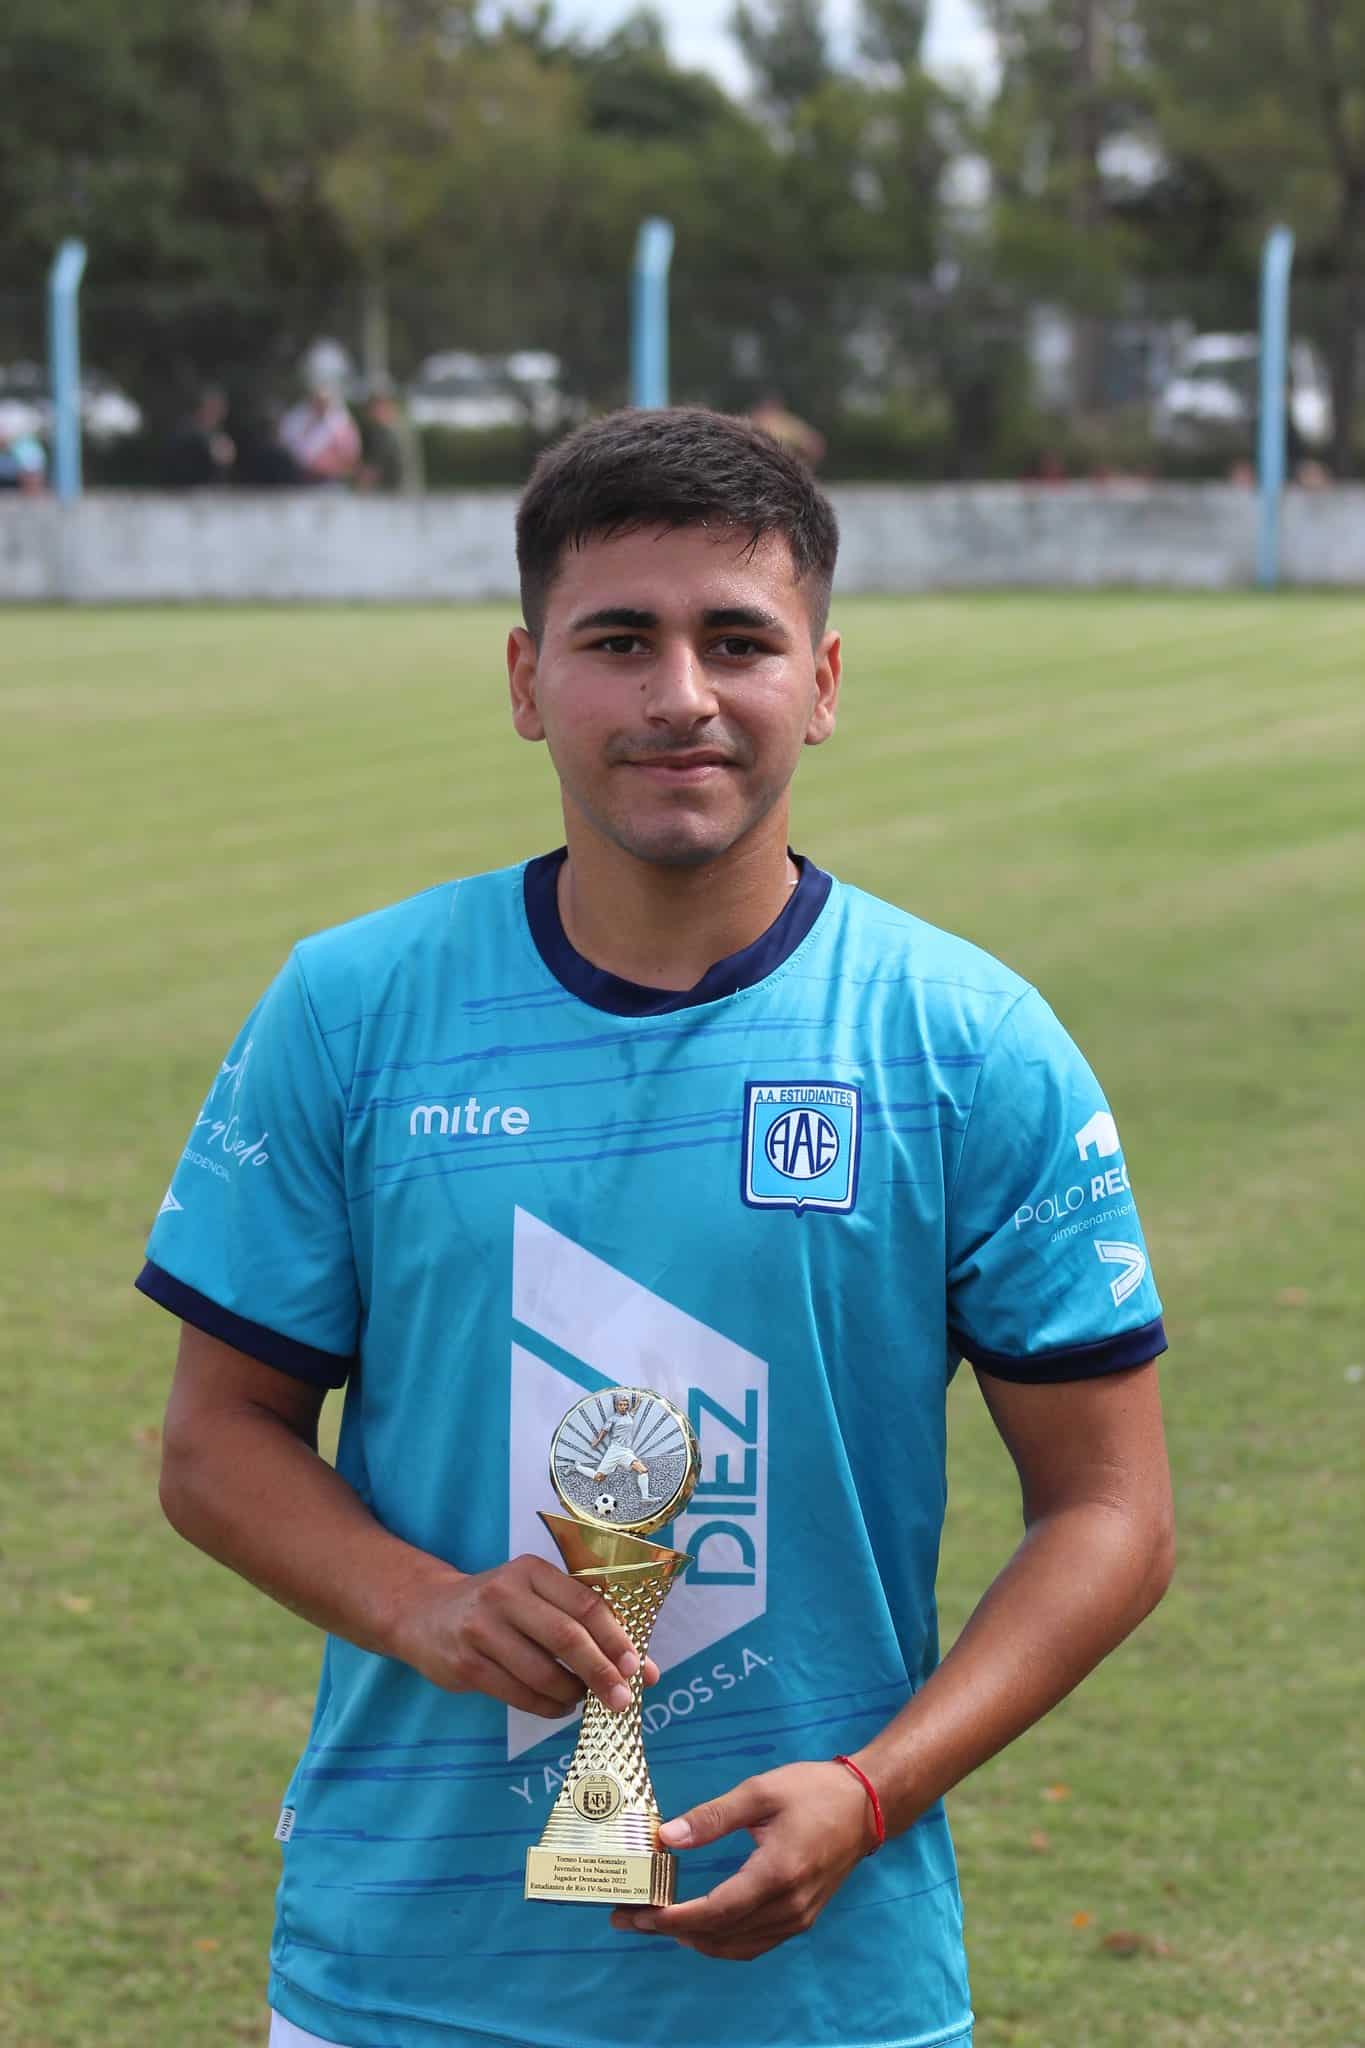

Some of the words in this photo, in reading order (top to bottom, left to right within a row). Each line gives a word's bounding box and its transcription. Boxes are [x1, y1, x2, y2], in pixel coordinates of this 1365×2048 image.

[409, 1097, 530, 1136] mitre
[756, 1089, 777, 1103] A.A.
[780, 1089, 853, 1105] ESTUDIANTES
[1014, 1186, 1085, 1231] POLO
[685, 1388, 758, 1586] DIEZ
[509, 1776, 533, 1804] Y
[711, 1647, 774, 1689] S.A.
